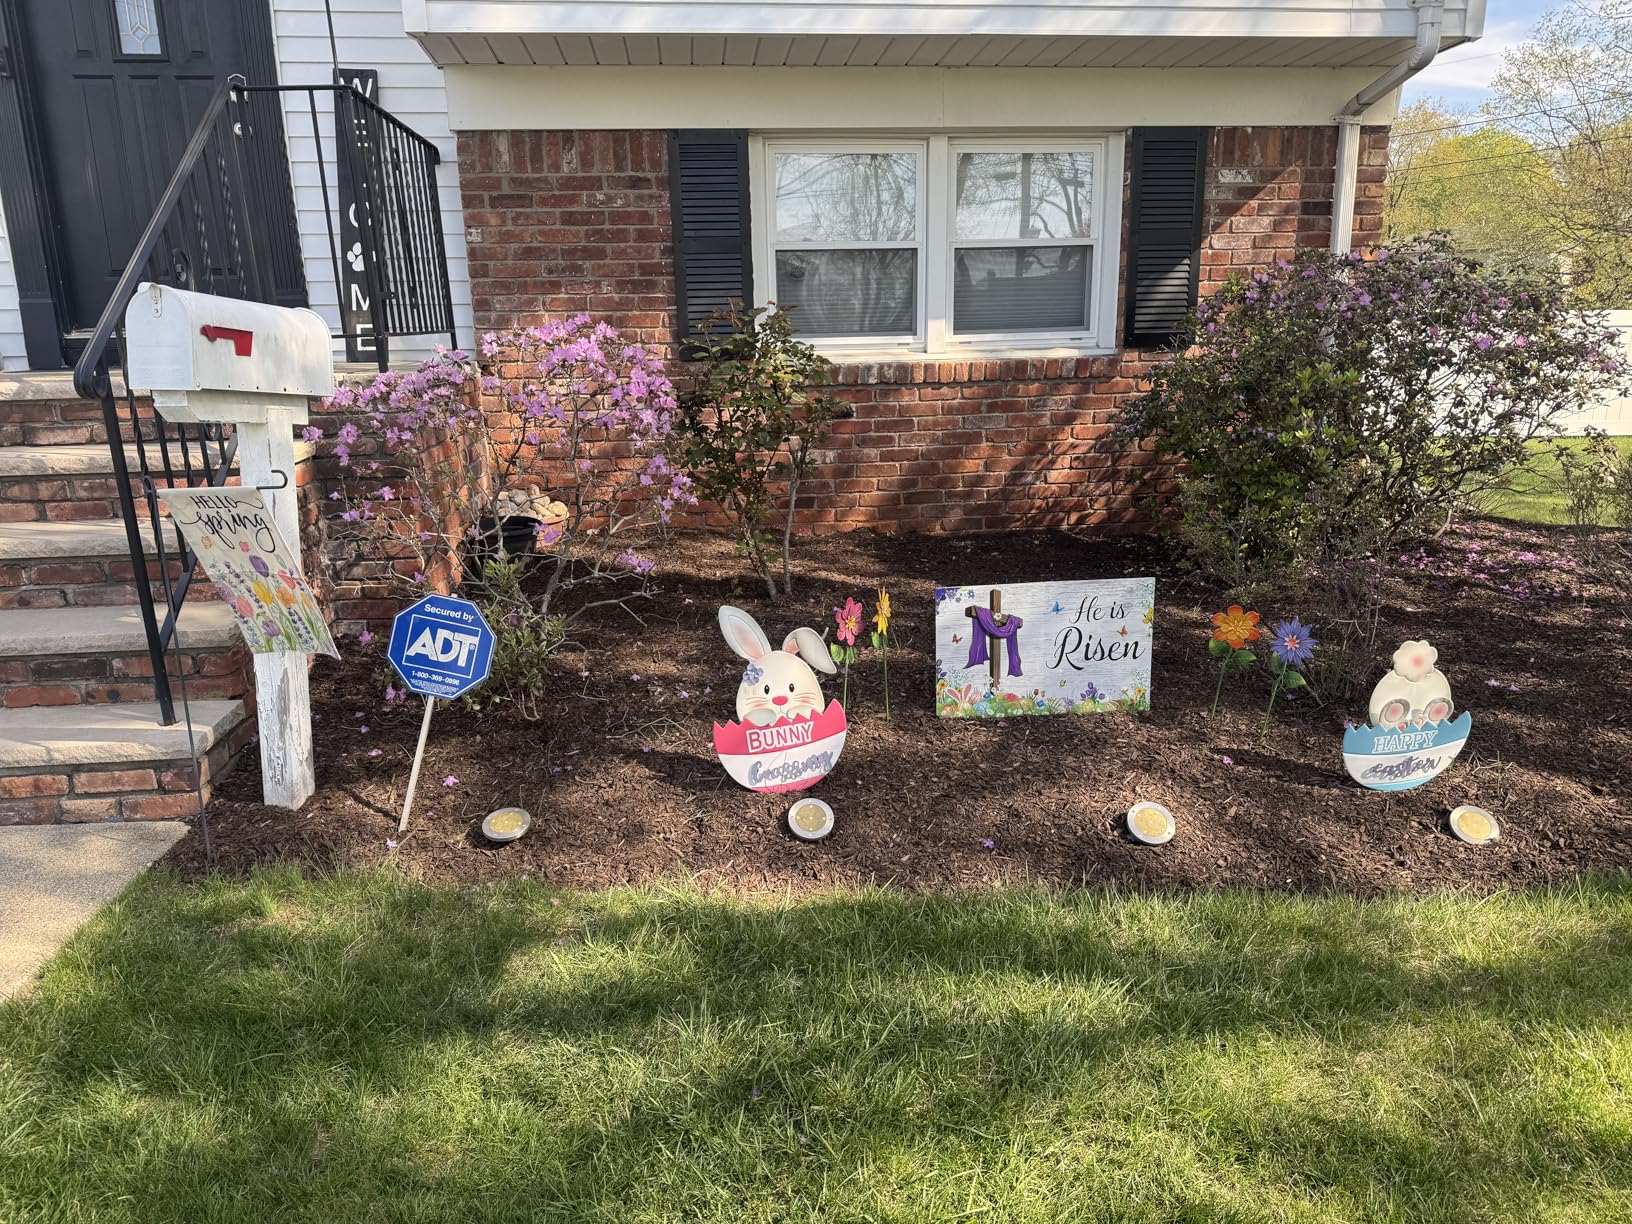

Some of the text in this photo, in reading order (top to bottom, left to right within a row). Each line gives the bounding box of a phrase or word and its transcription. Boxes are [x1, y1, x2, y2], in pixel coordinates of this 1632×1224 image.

[190, 495, 264, 509] HELLO
[180, 510, 276, 553] spring
[424, 603, 474, 623] Secured by
[1069, 595, 1130, 624] He is
[406, 627, 479, 667] ADT
[1045, 626, 1146, 671] Risen
[746, 721, 814, 752] BUNNY
[1371, 730, 1438, 754] HAPPY
